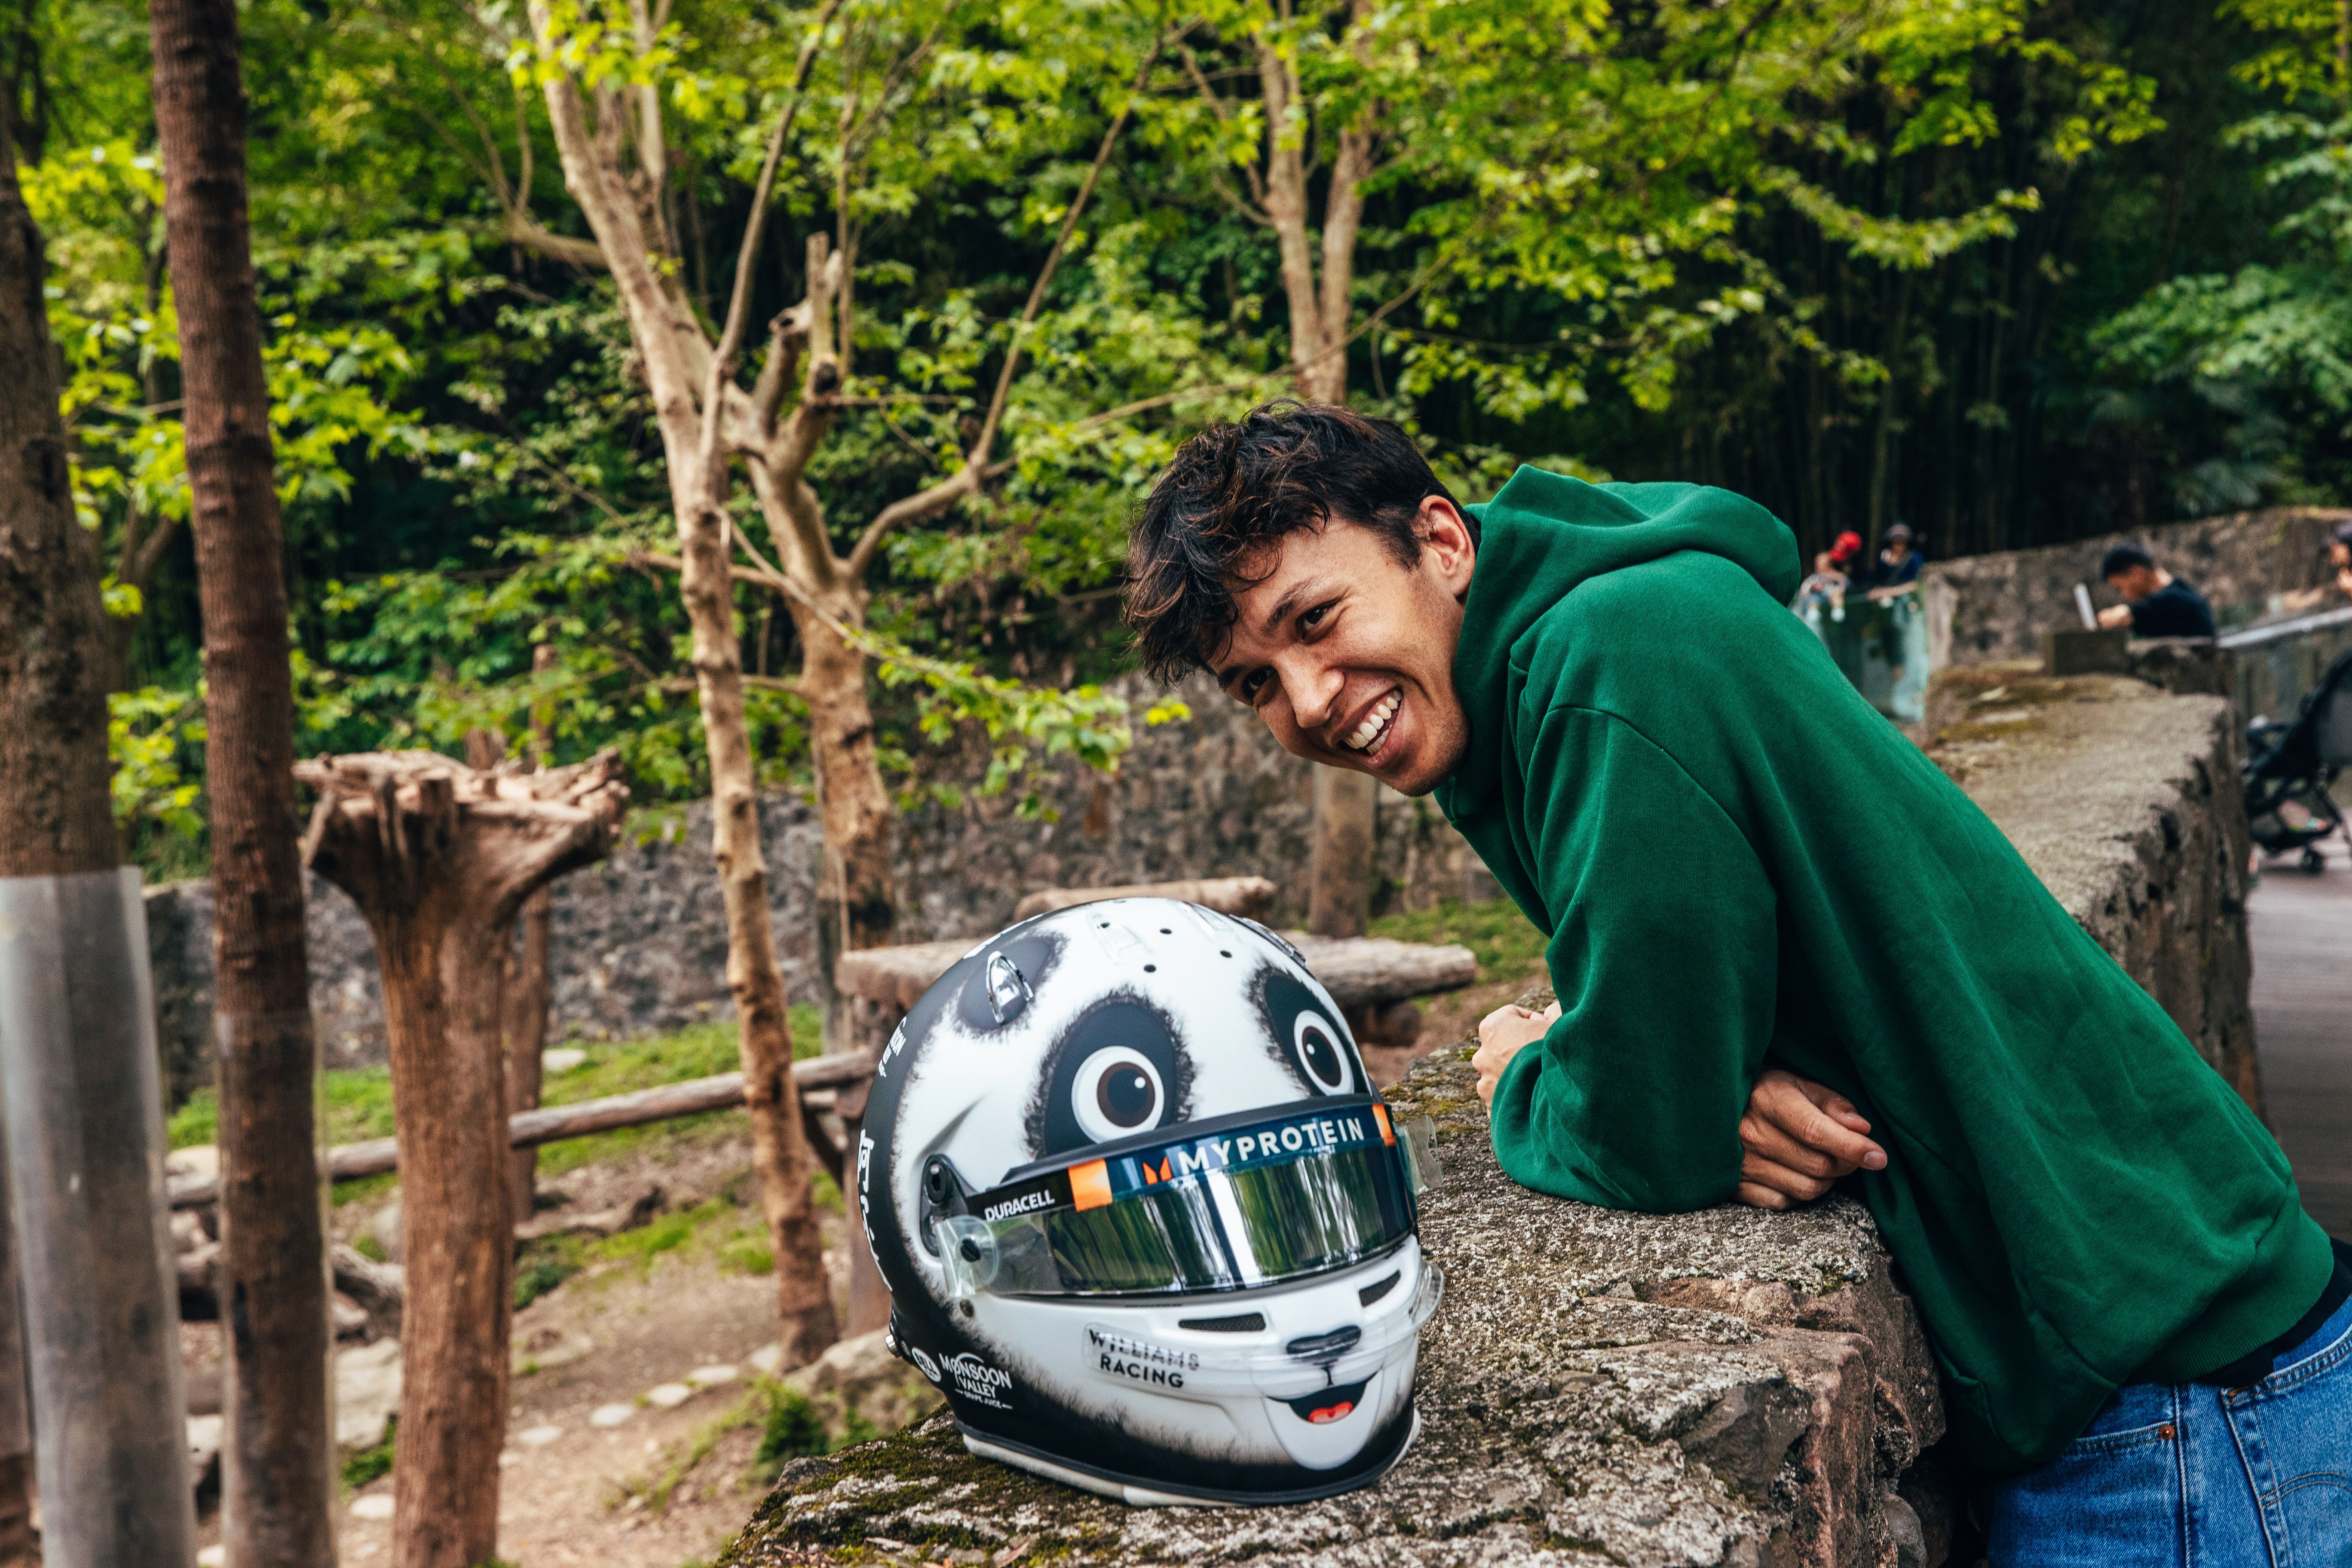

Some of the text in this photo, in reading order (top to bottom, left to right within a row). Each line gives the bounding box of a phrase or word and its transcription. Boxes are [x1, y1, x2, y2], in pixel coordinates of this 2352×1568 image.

[1178, 1118, 1365, 1174] MYPROTEIN
[984, 1189, 1055, 1222] DURACELL
[1089, 1329, 1199, 1371] WILLIAMS
[939, 1352, 1012, 1389] MONSOON
[959, 1376, 996, 1398] VALLEY
[1100, 1354, 1184, 1388] RACING
